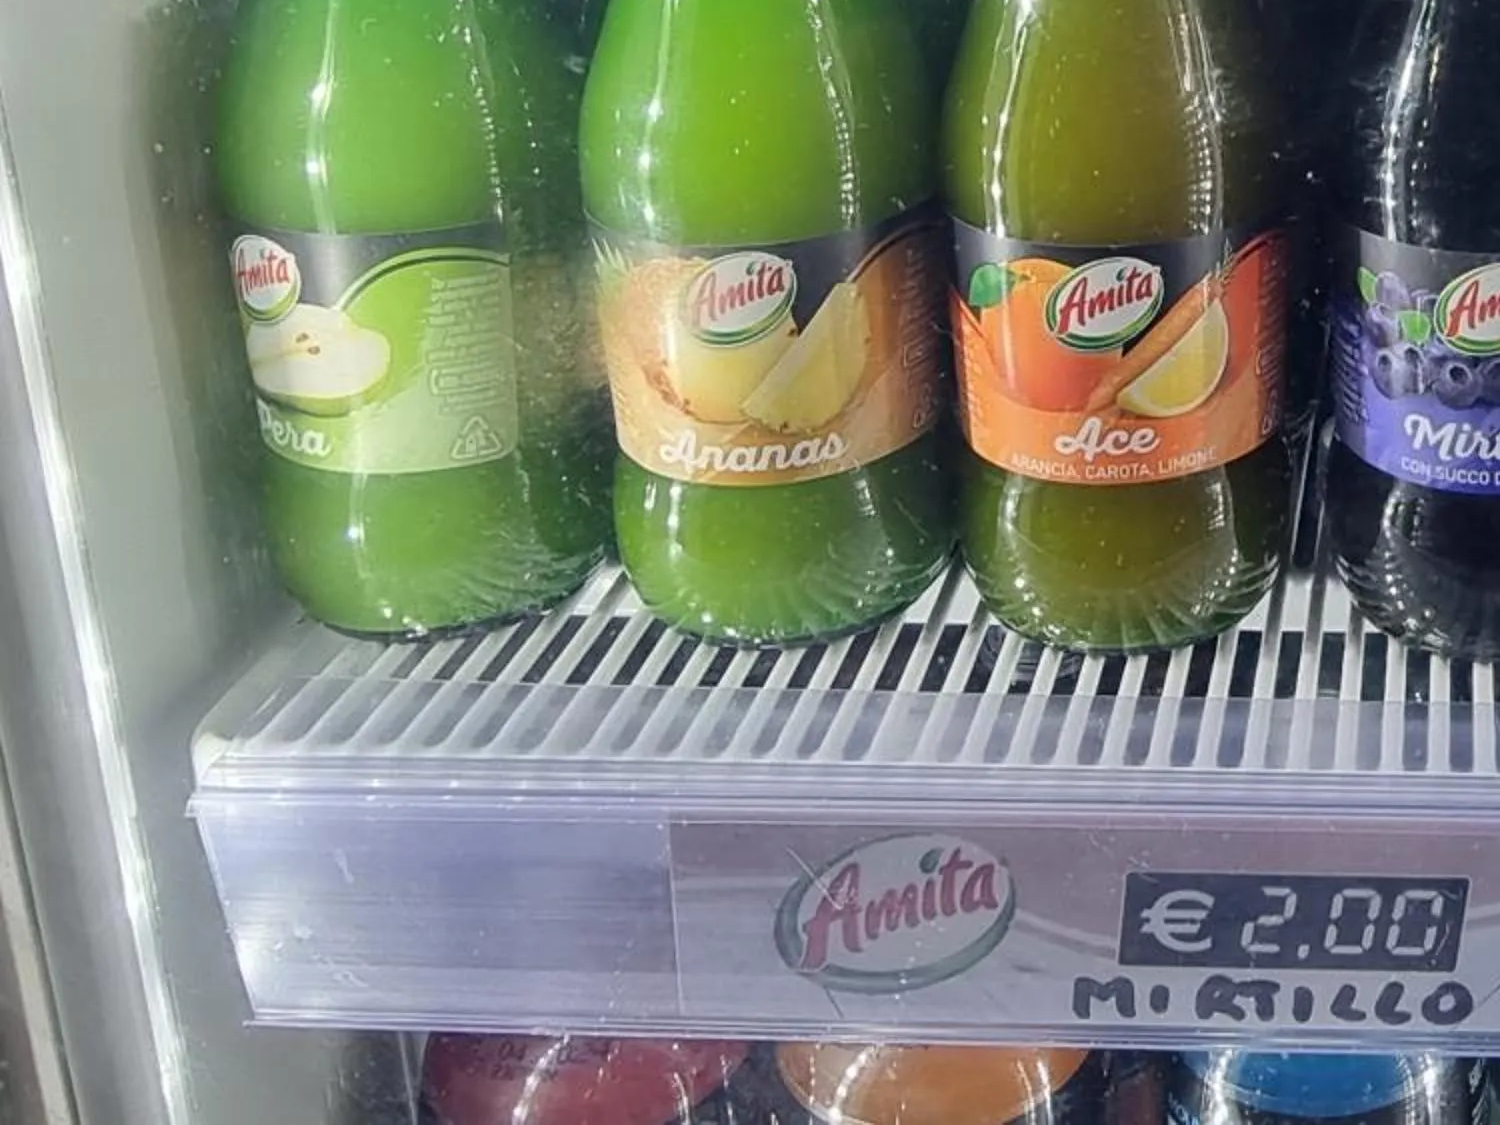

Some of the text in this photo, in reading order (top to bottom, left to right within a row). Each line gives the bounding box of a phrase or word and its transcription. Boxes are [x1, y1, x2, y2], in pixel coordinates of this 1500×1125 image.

[690, 261, 788, 322] Amita
[1057, 266, 1156, 335] Amita
[659, 430, 847, 474] Ananas
[1054, 416, 1161, 461] Ace
[1401, 456, 1431, 480] CON
[1435, 463, 1489, 485] SUCCO
[801, 846, 1002, 971] Amita
[1071, 974, 1475, 1025] MIRTILLO
